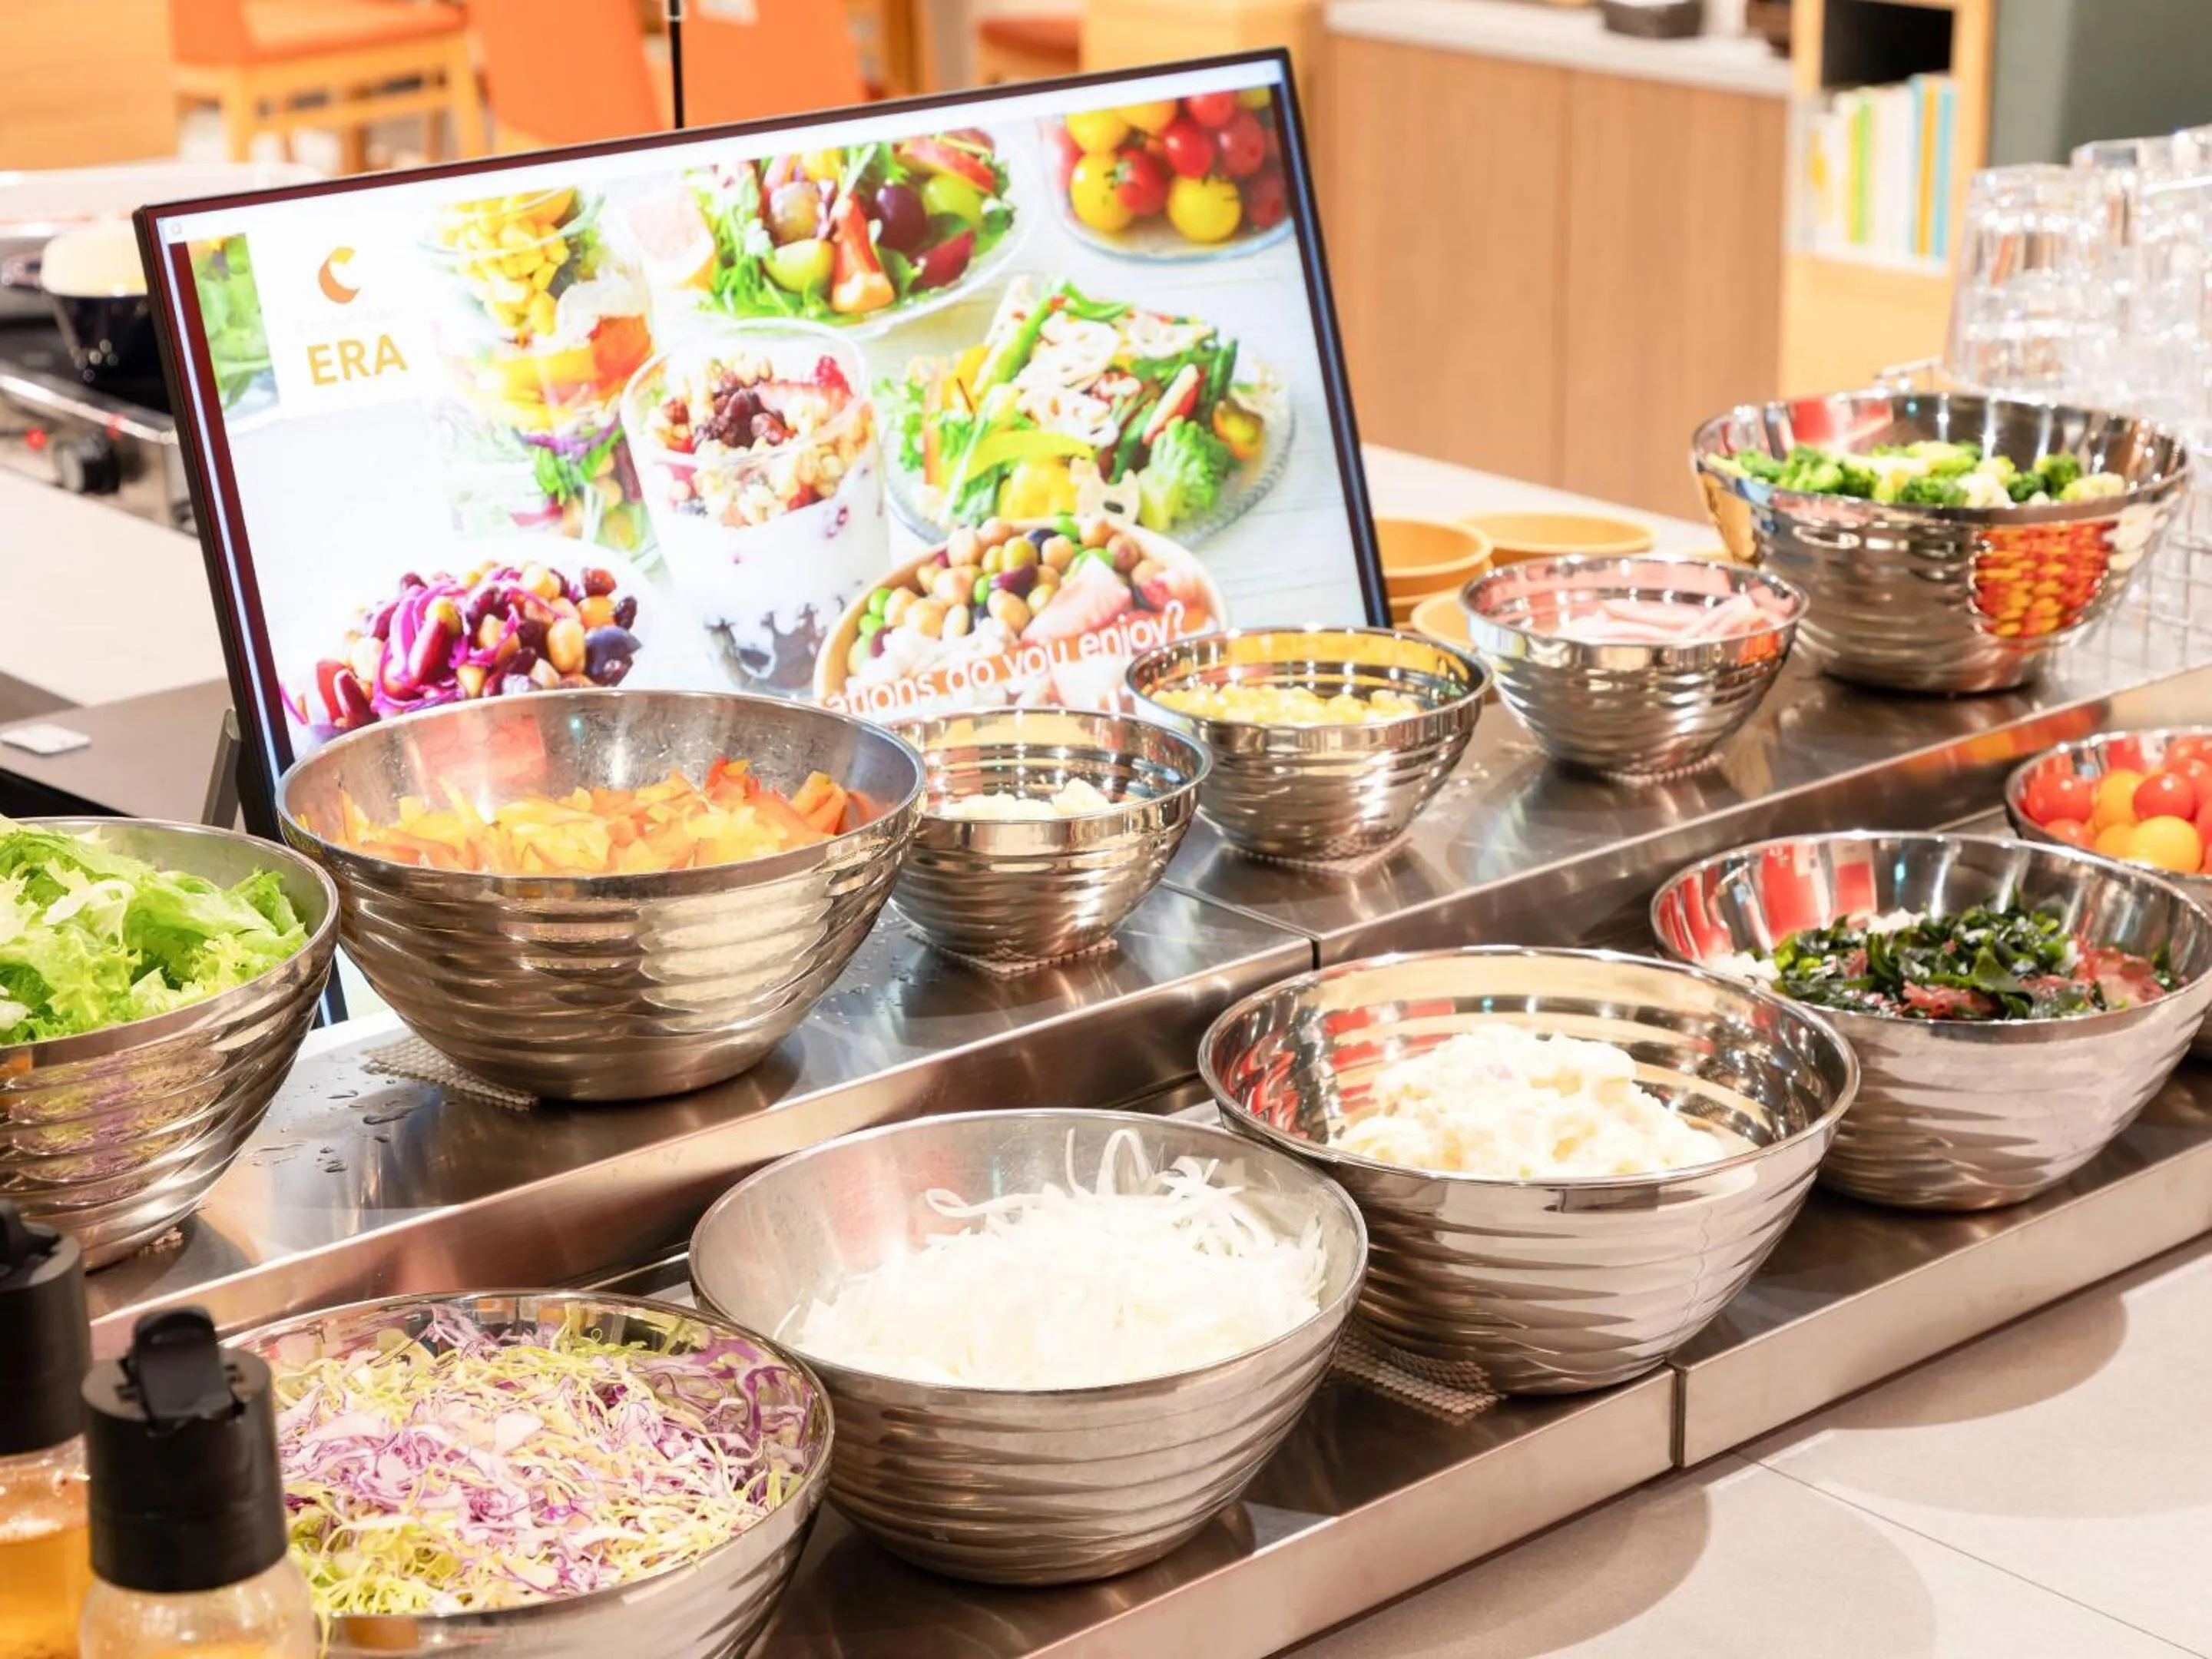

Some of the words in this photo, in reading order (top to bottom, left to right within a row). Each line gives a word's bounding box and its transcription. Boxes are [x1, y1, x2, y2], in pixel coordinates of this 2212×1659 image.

[306, 333, 409, 386] ERA
[945, 650, 995, 693] do
[1002, 638, 1069, 684] you
[1078, 599, 1185, 664] enjoy?
